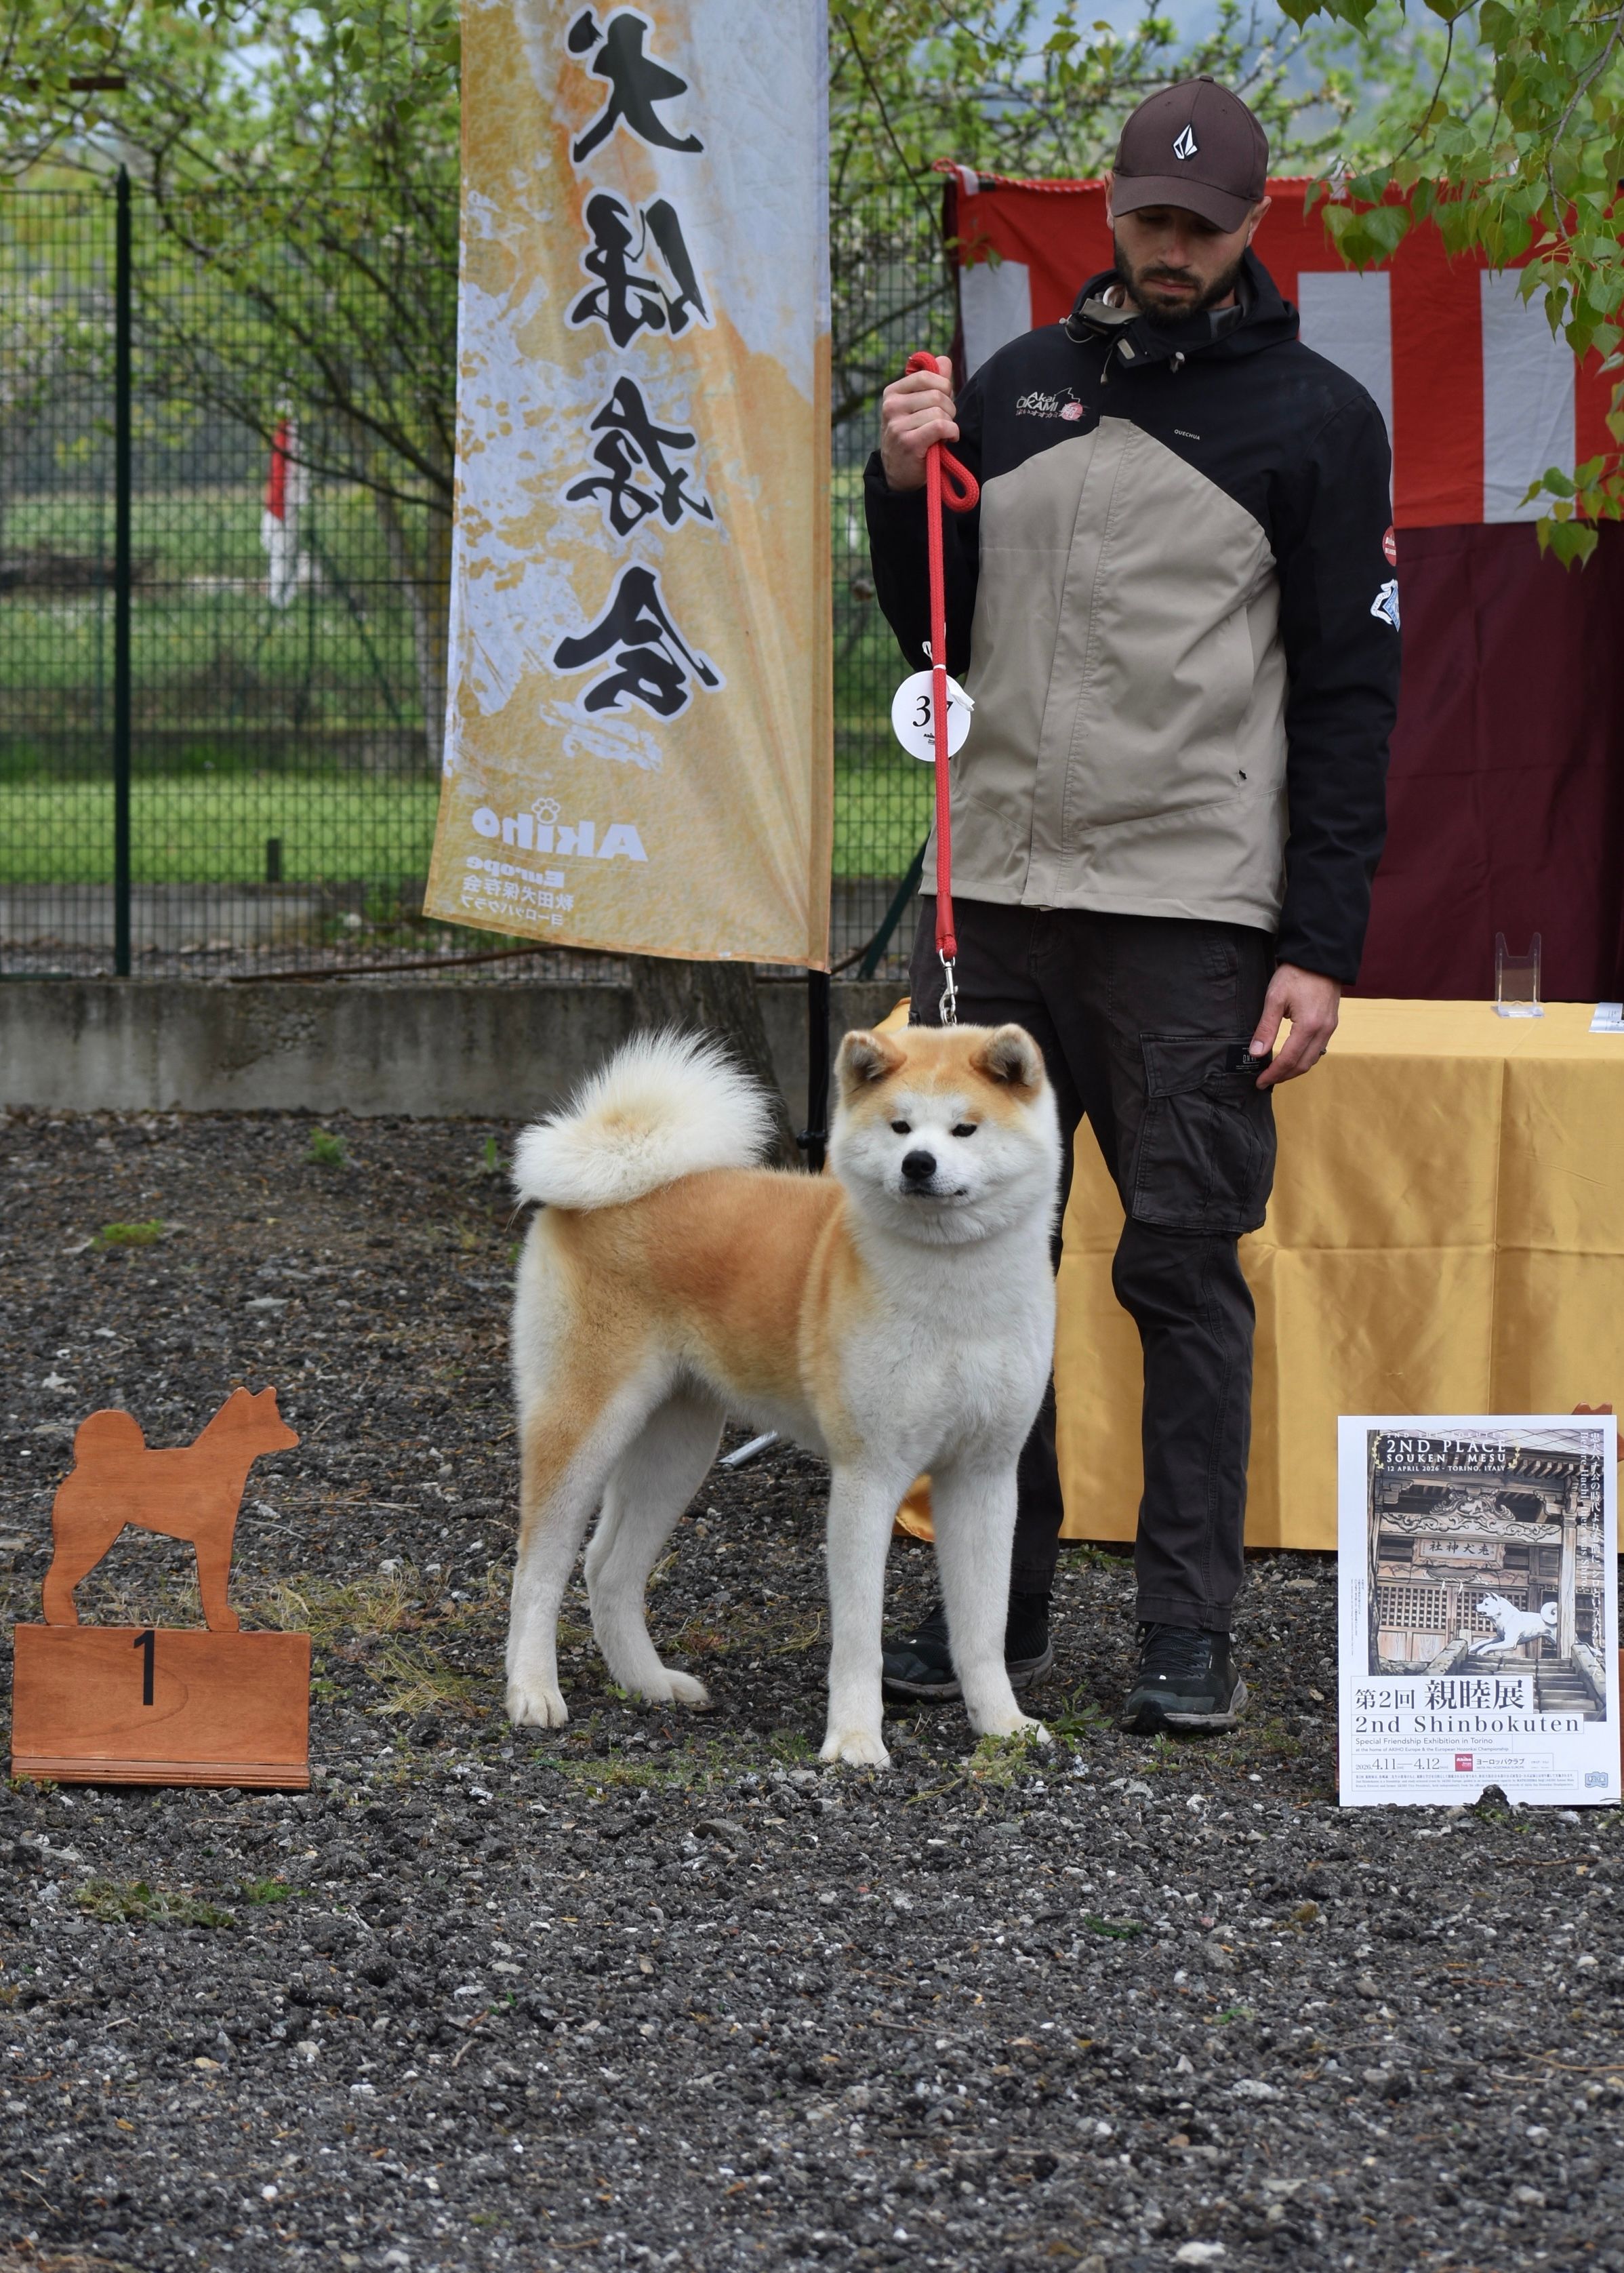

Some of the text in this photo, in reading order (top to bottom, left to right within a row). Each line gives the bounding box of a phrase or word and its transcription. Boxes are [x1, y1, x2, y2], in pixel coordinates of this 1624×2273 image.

[1028, 391, 1057, 403] Akai
[1174, 429, 1200, 440] QUECHUA
[1386, 1439, 1506, 1453] 2ND PLACE
[1581, 1432, 1589, 1465] Befre
[1386, 1453, 1445, 1463] SOUKEN
[1467, 1453, 1506, 1462] MESU
[133, 1630, 155, 1706] 1
[1355, 1679, 1525, 1710] 第2回 親睦展
[1355, 1715, 1579, 1733] 2nd Shinbokuten
[1356, 1737, 1381, 1748] Special
[1383, 1737, 1421, 1747] Friendship
[1423, 1737, 1460, 1745] Exhibition
